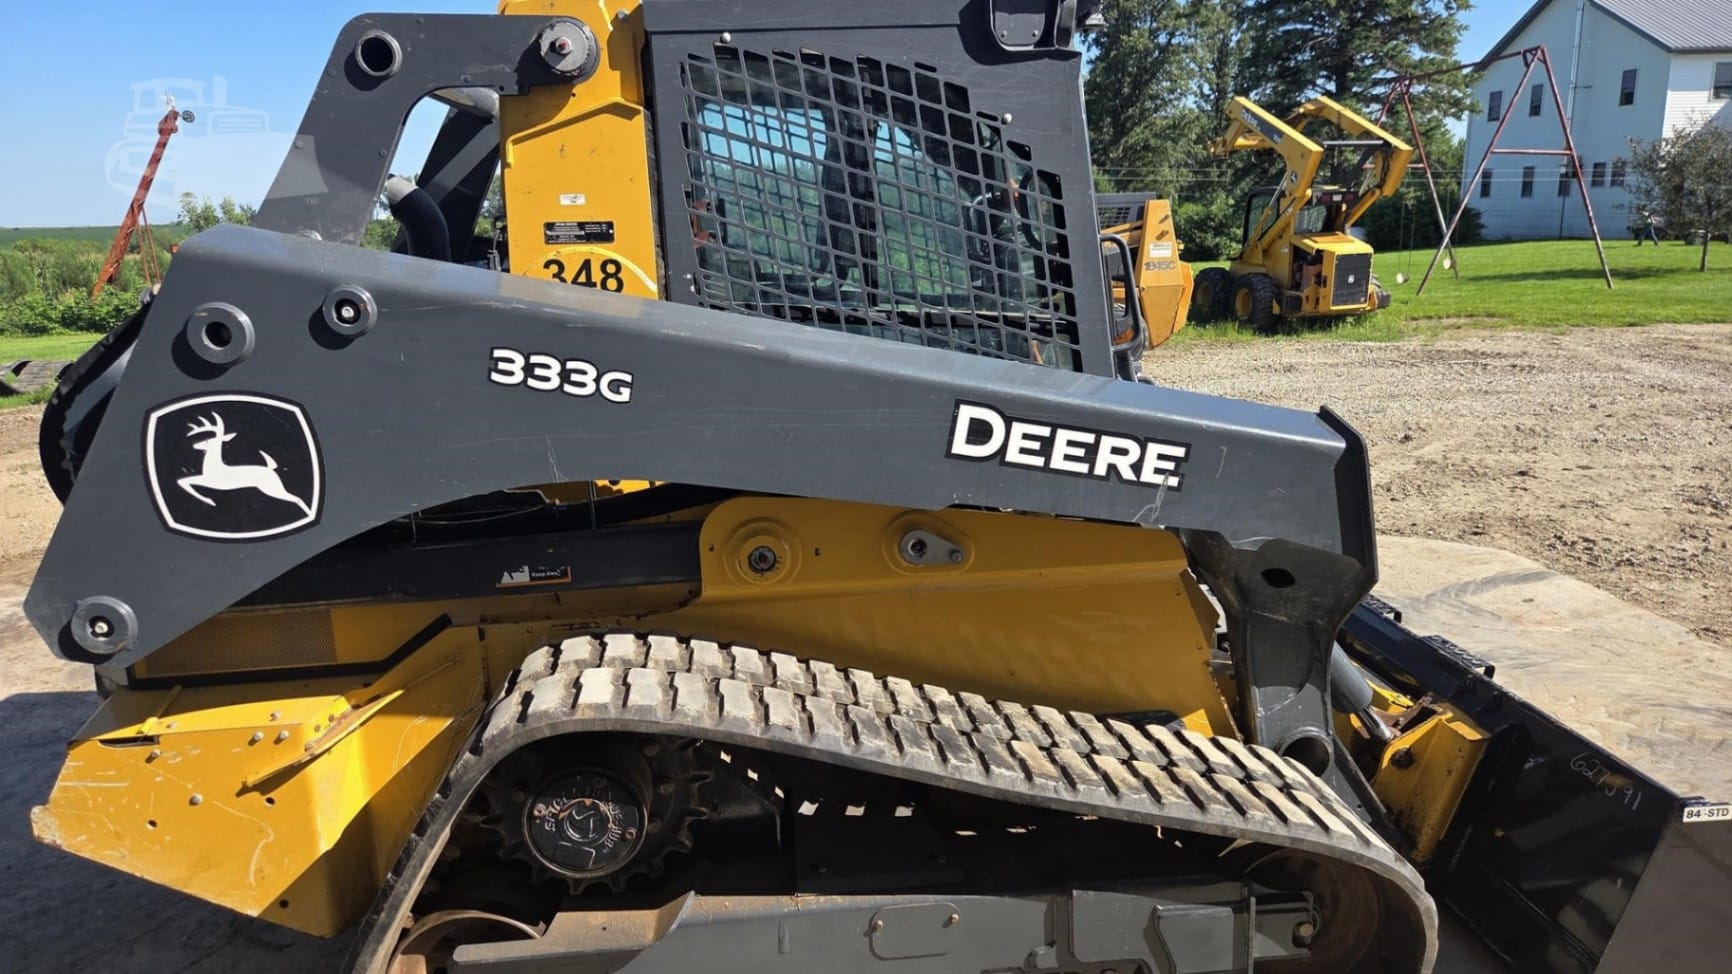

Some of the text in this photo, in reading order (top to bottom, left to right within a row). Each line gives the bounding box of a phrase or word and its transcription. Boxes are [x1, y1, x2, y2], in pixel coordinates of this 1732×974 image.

[543, 259, 624, 293] 348
[489, 348, 633, 403] 333G
[950, 403, 1187, 487] DEERE
